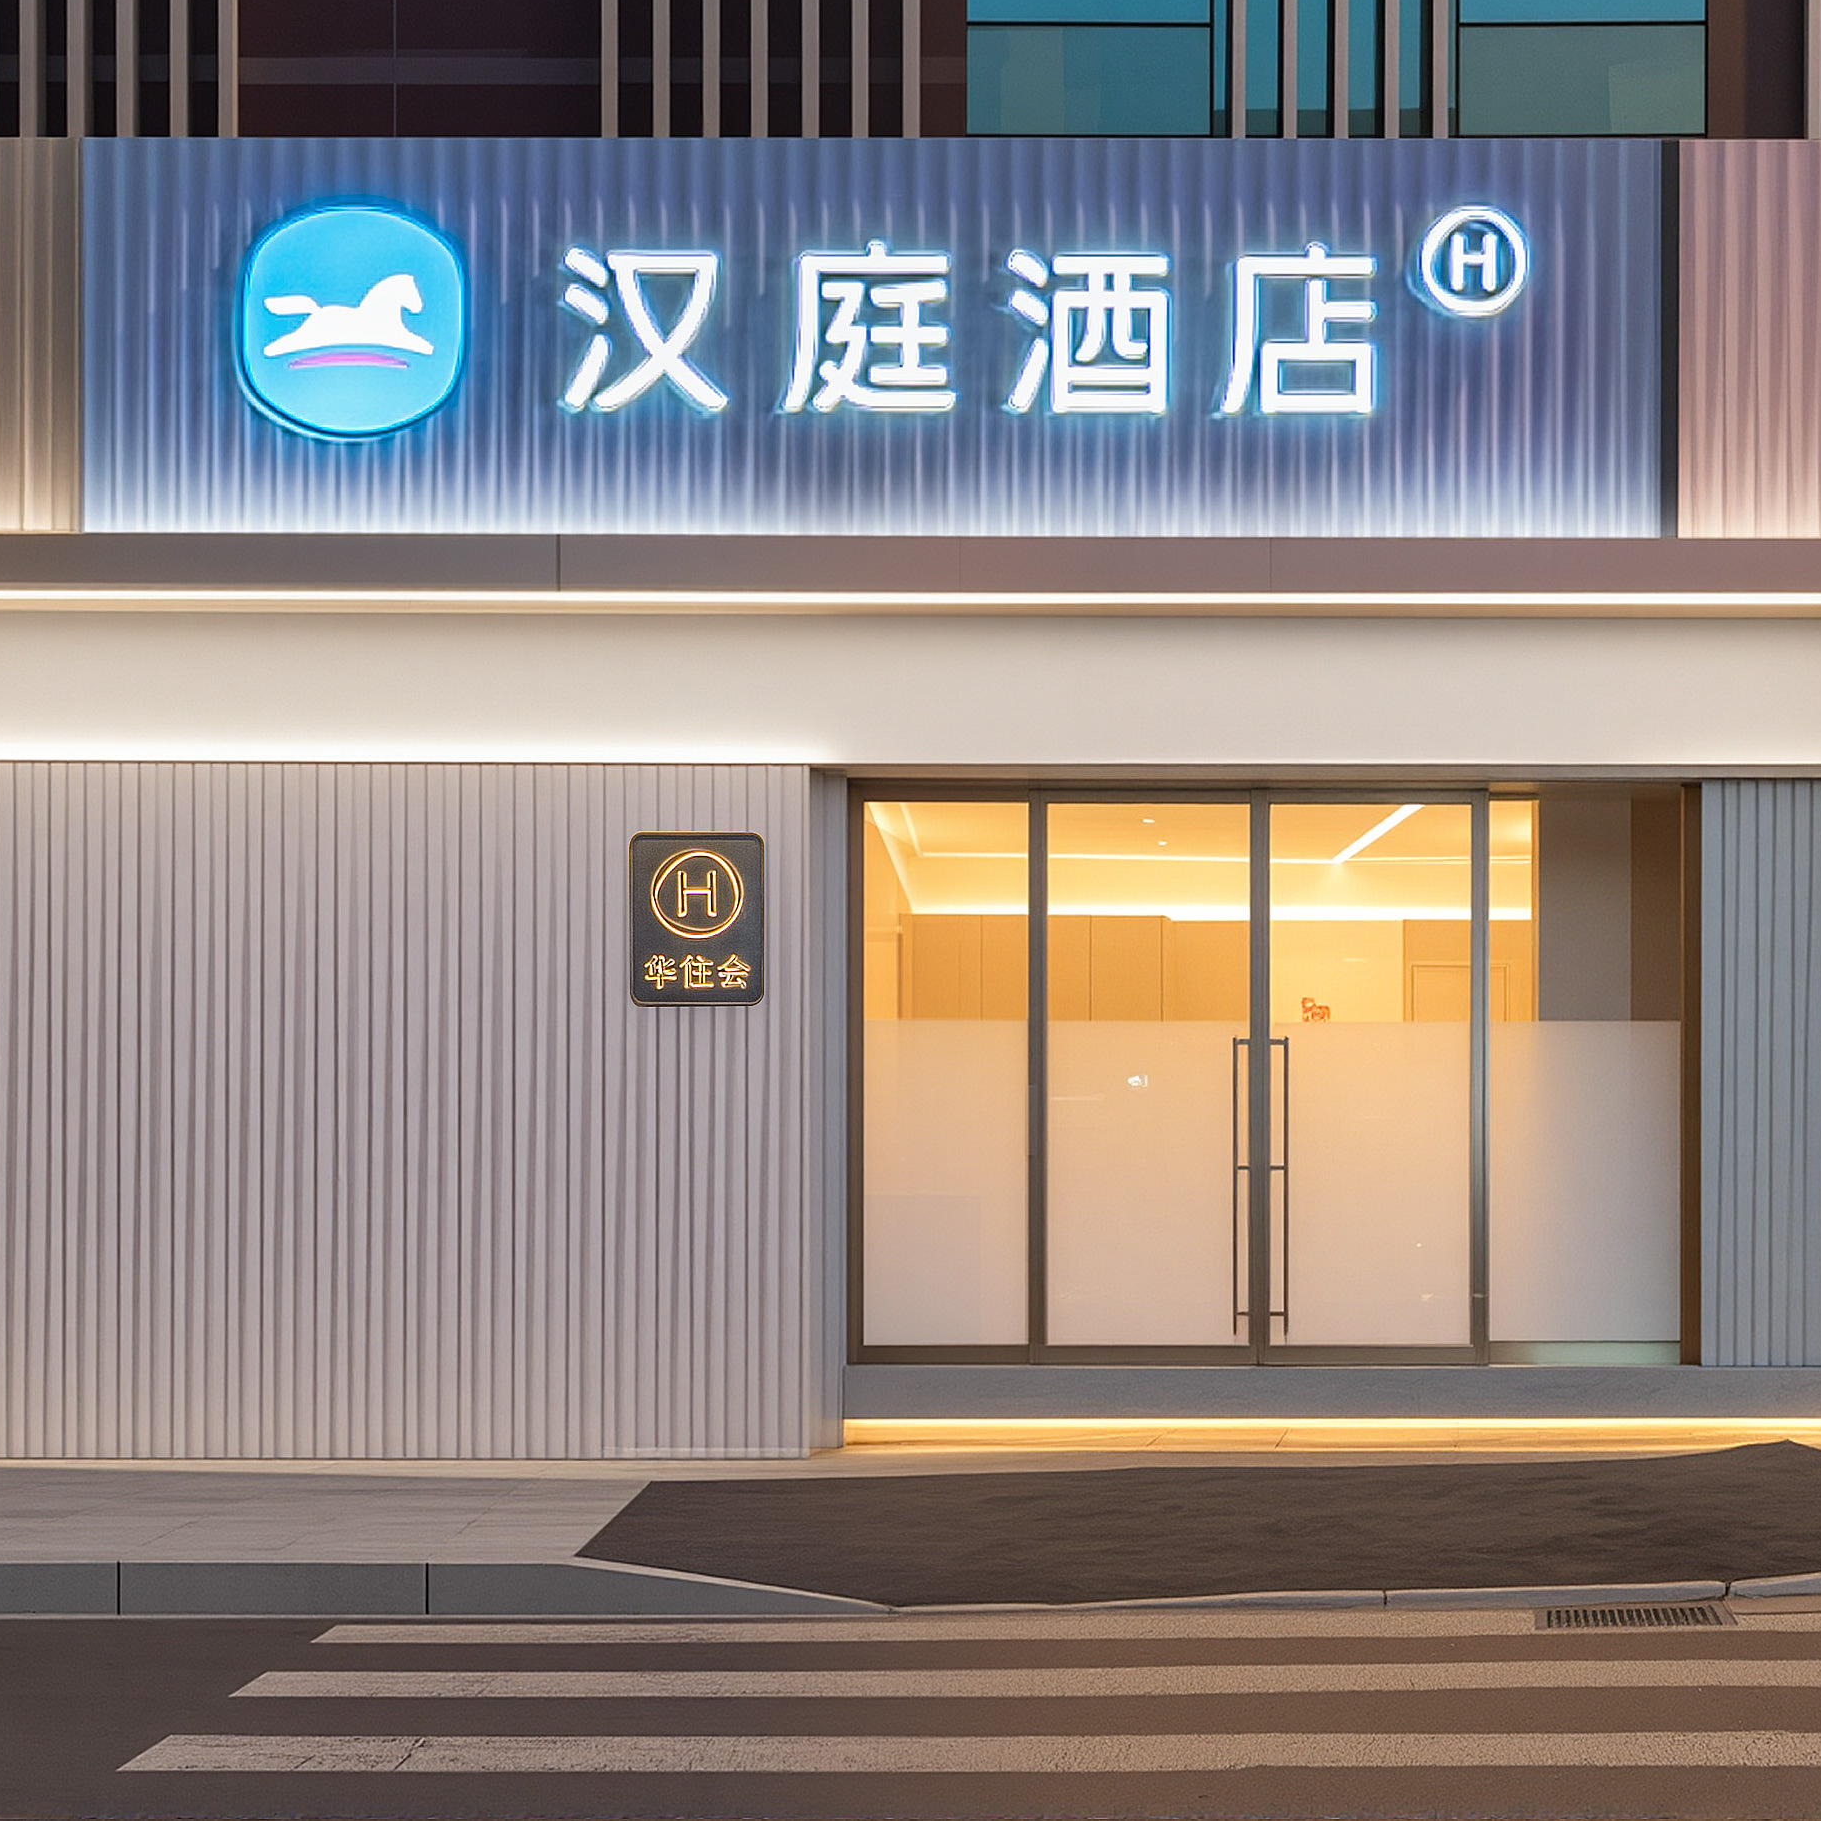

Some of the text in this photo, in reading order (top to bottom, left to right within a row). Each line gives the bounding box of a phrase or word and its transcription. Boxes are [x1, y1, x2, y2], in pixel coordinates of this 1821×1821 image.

[562, 240, 1380, 415] 汉庭酒店
[677, 870, 717, 918] H
[643, 953, 752, 990] 华住会
